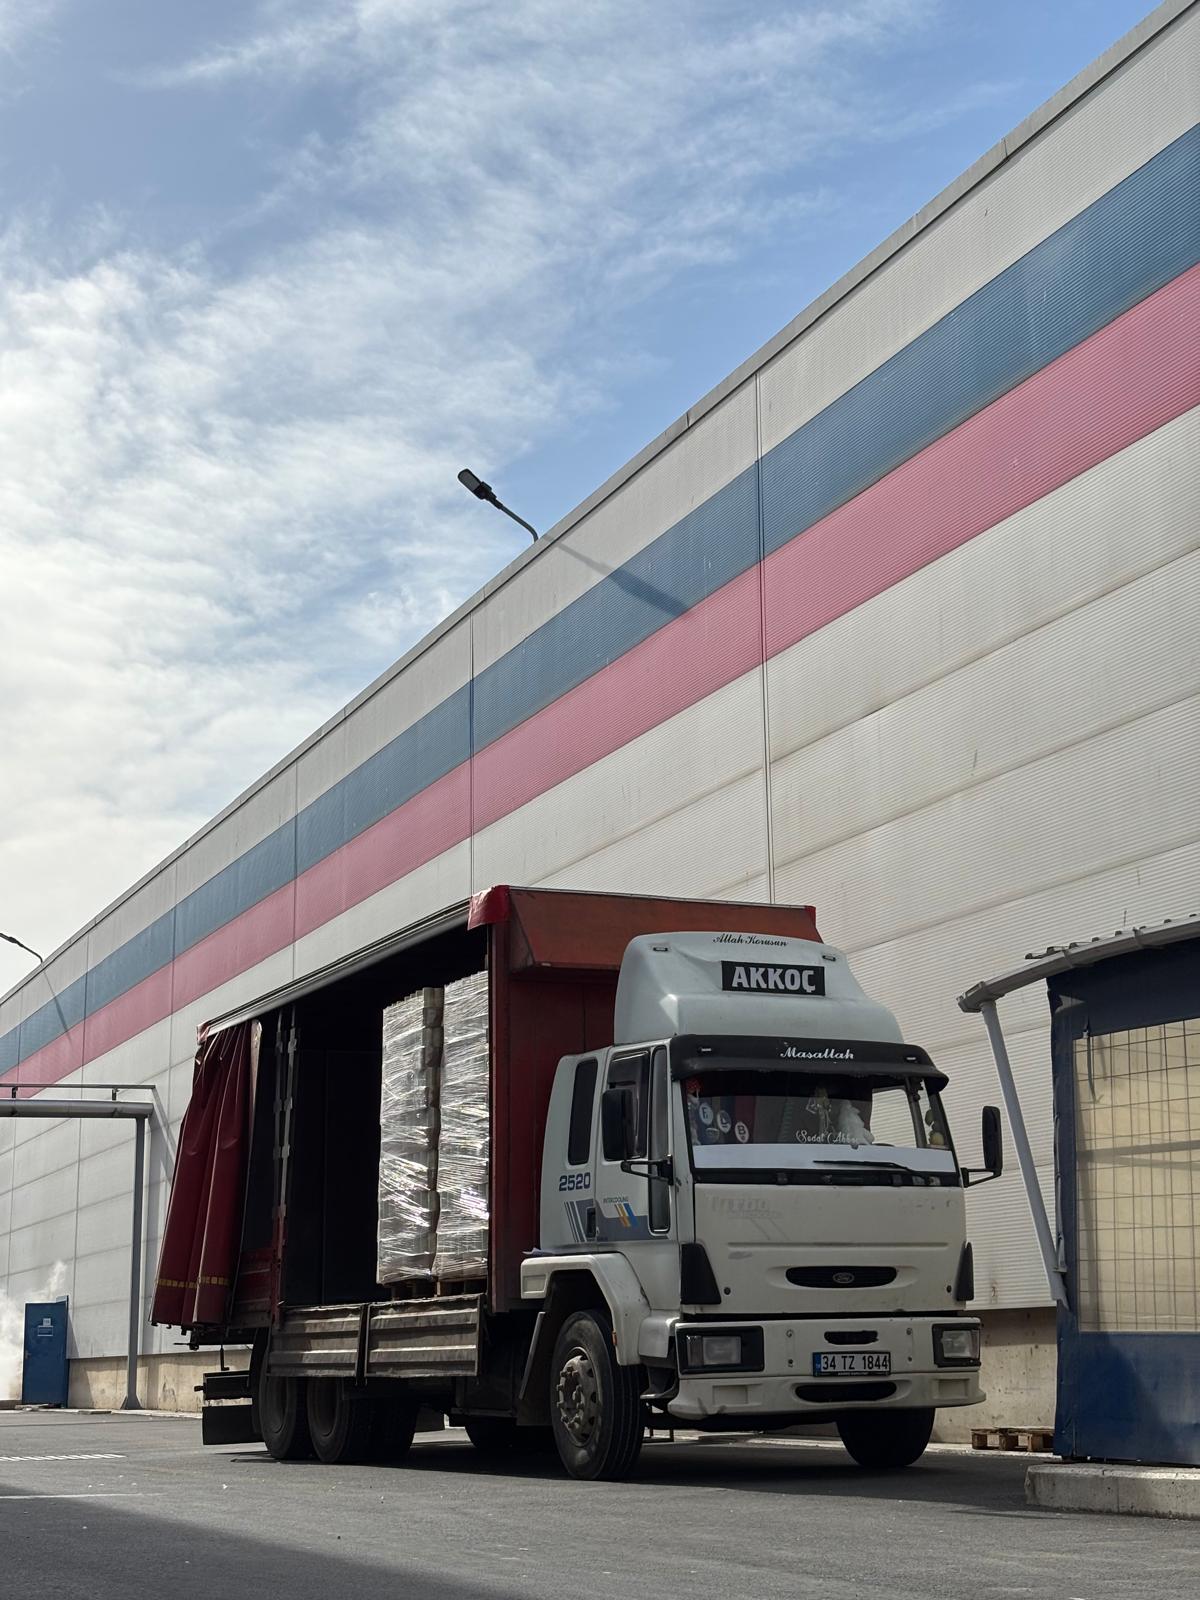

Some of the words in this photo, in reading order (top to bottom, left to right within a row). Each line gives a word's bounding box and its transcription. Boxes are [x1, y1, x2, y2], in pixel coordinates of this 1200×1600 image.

[713, 933, 743, 944] Allah
[745, 935, 788, 947] Korusun
[732, 966, 816, 993] AKKOÇ
[780, 1046, 854, 1060] Masallah
[559, 1172, 591, 1192] 2520
[822, 1355, 836, 1370] 34
[841, 1355, 855, 1370] TZ
[862, 1355, 888, 1370] 1844
